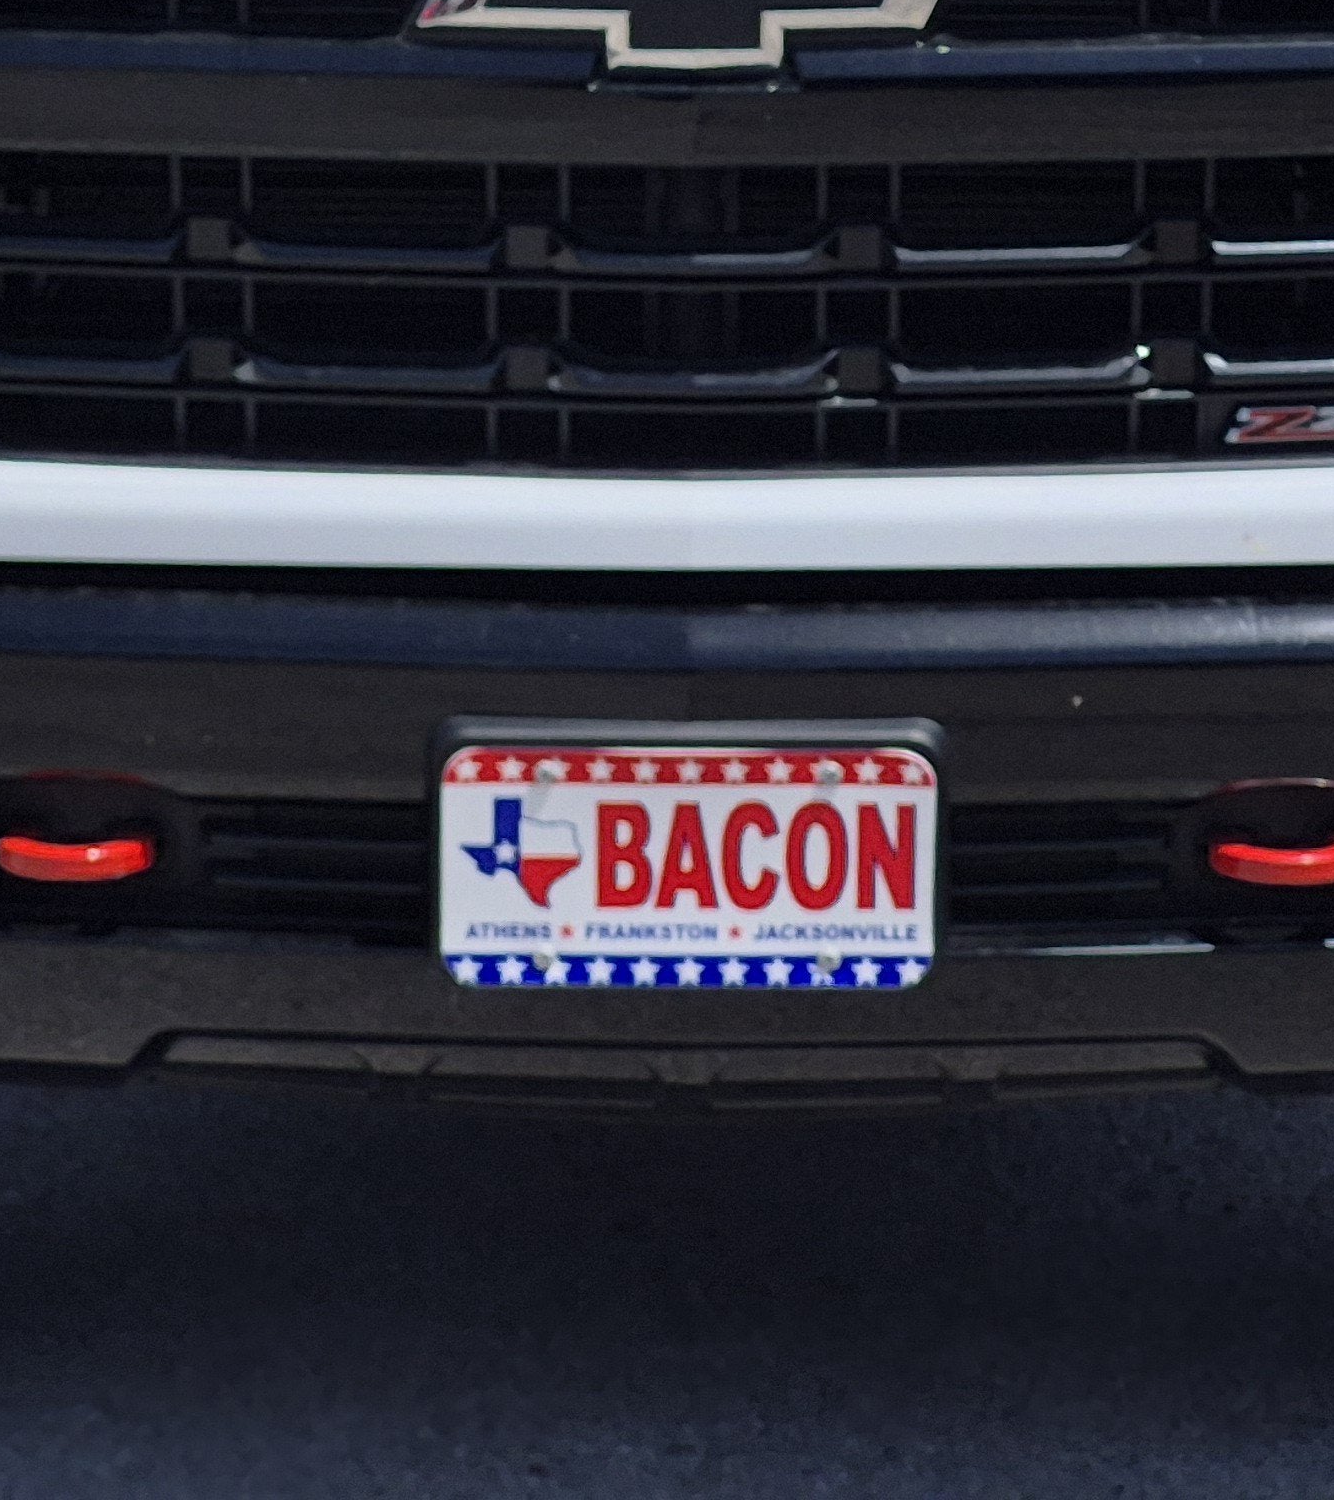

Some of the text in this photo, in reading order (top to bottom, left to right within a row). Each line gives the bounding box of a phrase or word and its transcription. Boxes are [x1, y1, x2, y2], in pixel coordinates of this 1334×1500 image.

[596, 802, 917, 910] BACON
[466, 922, 917, 941] ATHENS FRANKSTON JACKSONVILLE
